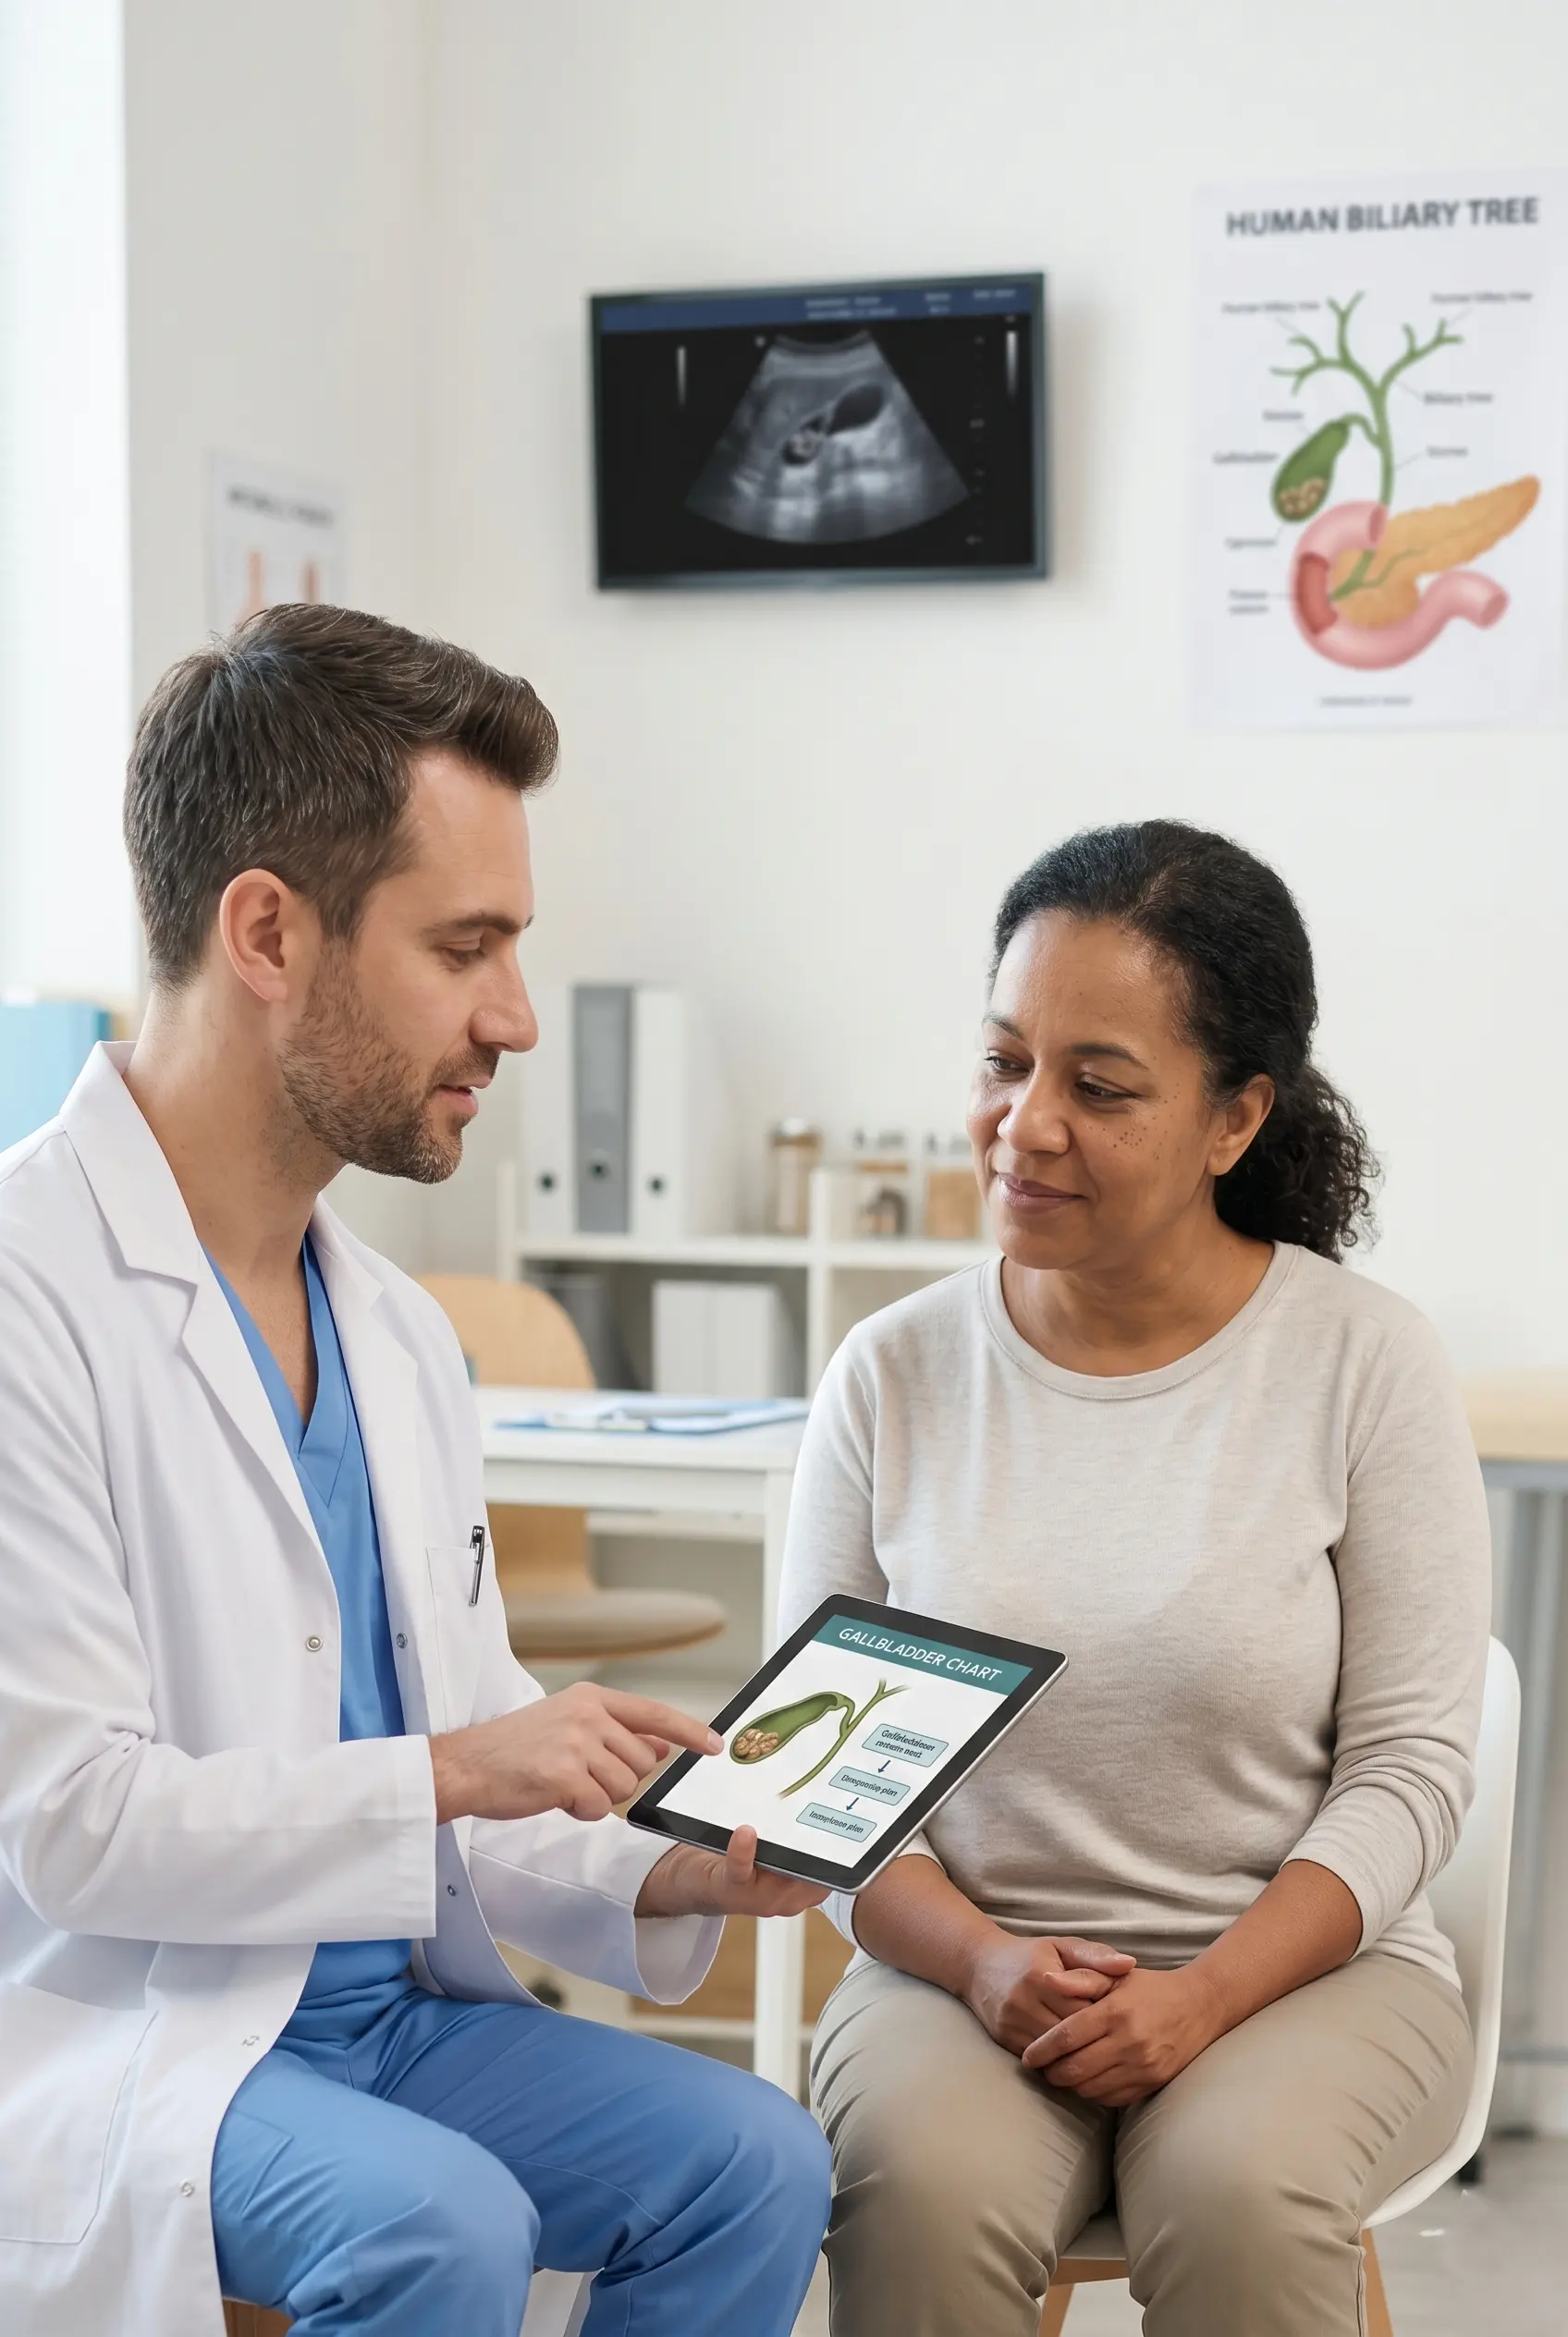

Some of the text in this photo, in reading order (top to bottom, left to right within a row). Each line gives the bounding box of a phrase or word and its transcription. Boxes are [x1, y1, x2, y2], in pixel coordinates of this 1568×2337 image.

[1227, 196, 1540, 236] HUMAN BILIARY TREE
[839, 1628, 1003, 1682] GALLBLADDER CHART
